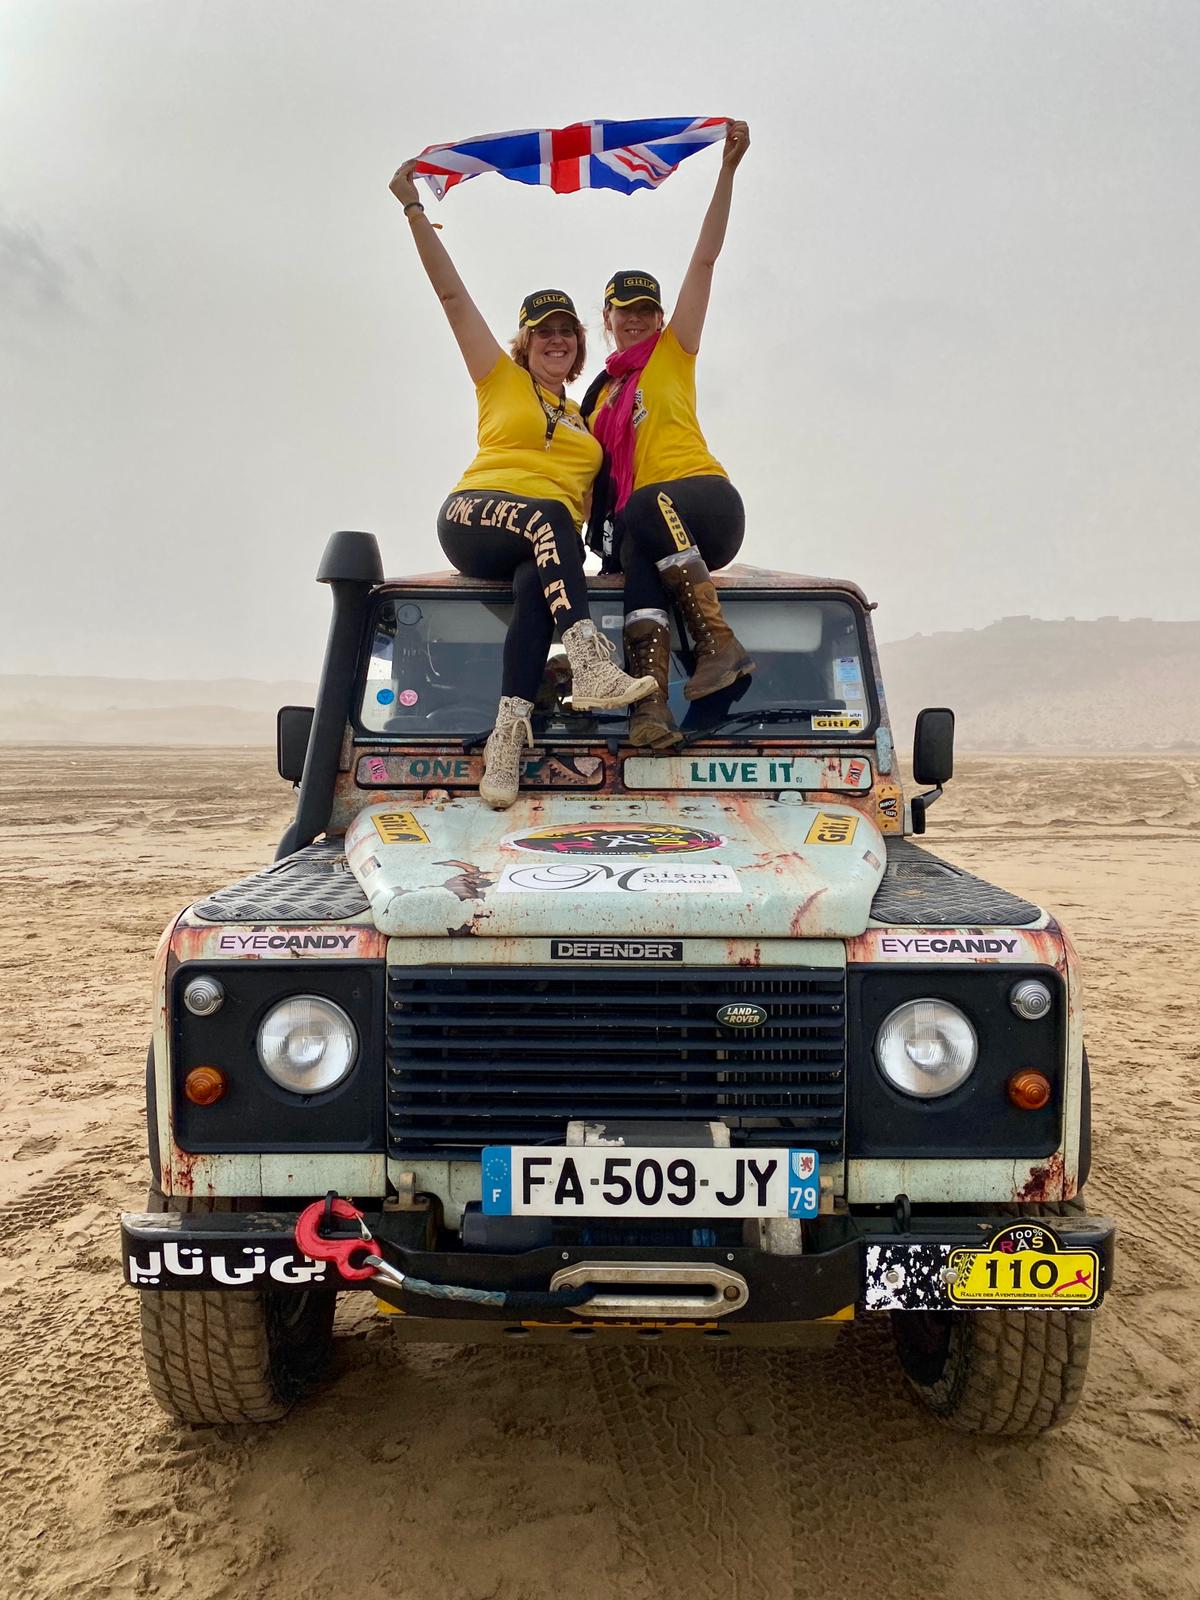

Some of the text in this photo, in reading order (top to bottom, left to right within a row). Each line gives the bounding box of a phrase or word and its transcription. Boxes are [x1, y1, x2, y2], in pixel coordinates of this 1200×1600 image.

[445, 496, 483, 527] ONE
[480, 499, 527, 534] LIFE
[816, 719, 844, 728] Giti
[409, 759, 471, 778] ONE
[691, 762, 758, 783] LIVE
[378, 814, 412, 831] Giti
[582, 832, 684, 841] 100%
[817, 820, 850, 843] Giti
[551, 837, 690, 852] RAS
[508, 863, 729, 892] Maison
[220, 935, 357, 949] EYECANDY
[557, 942, 675, 959] DEFENDER
[881, 938, 1018, 953] EYECANDY
[727, 1007, 753, 1015] LAND
[729, 1015, 760, 1023] ROVER
[522, 1157, 778, 1207] FA-509-JY
[492, 1189, 502, 1203] F
[789, 1187, 817, 1211] 79
[1009, 1228, 1044, 1240] 100%
[1000, 1236, 1044, 1253] RAS
[985, 1259, 1059, 1290] 110
